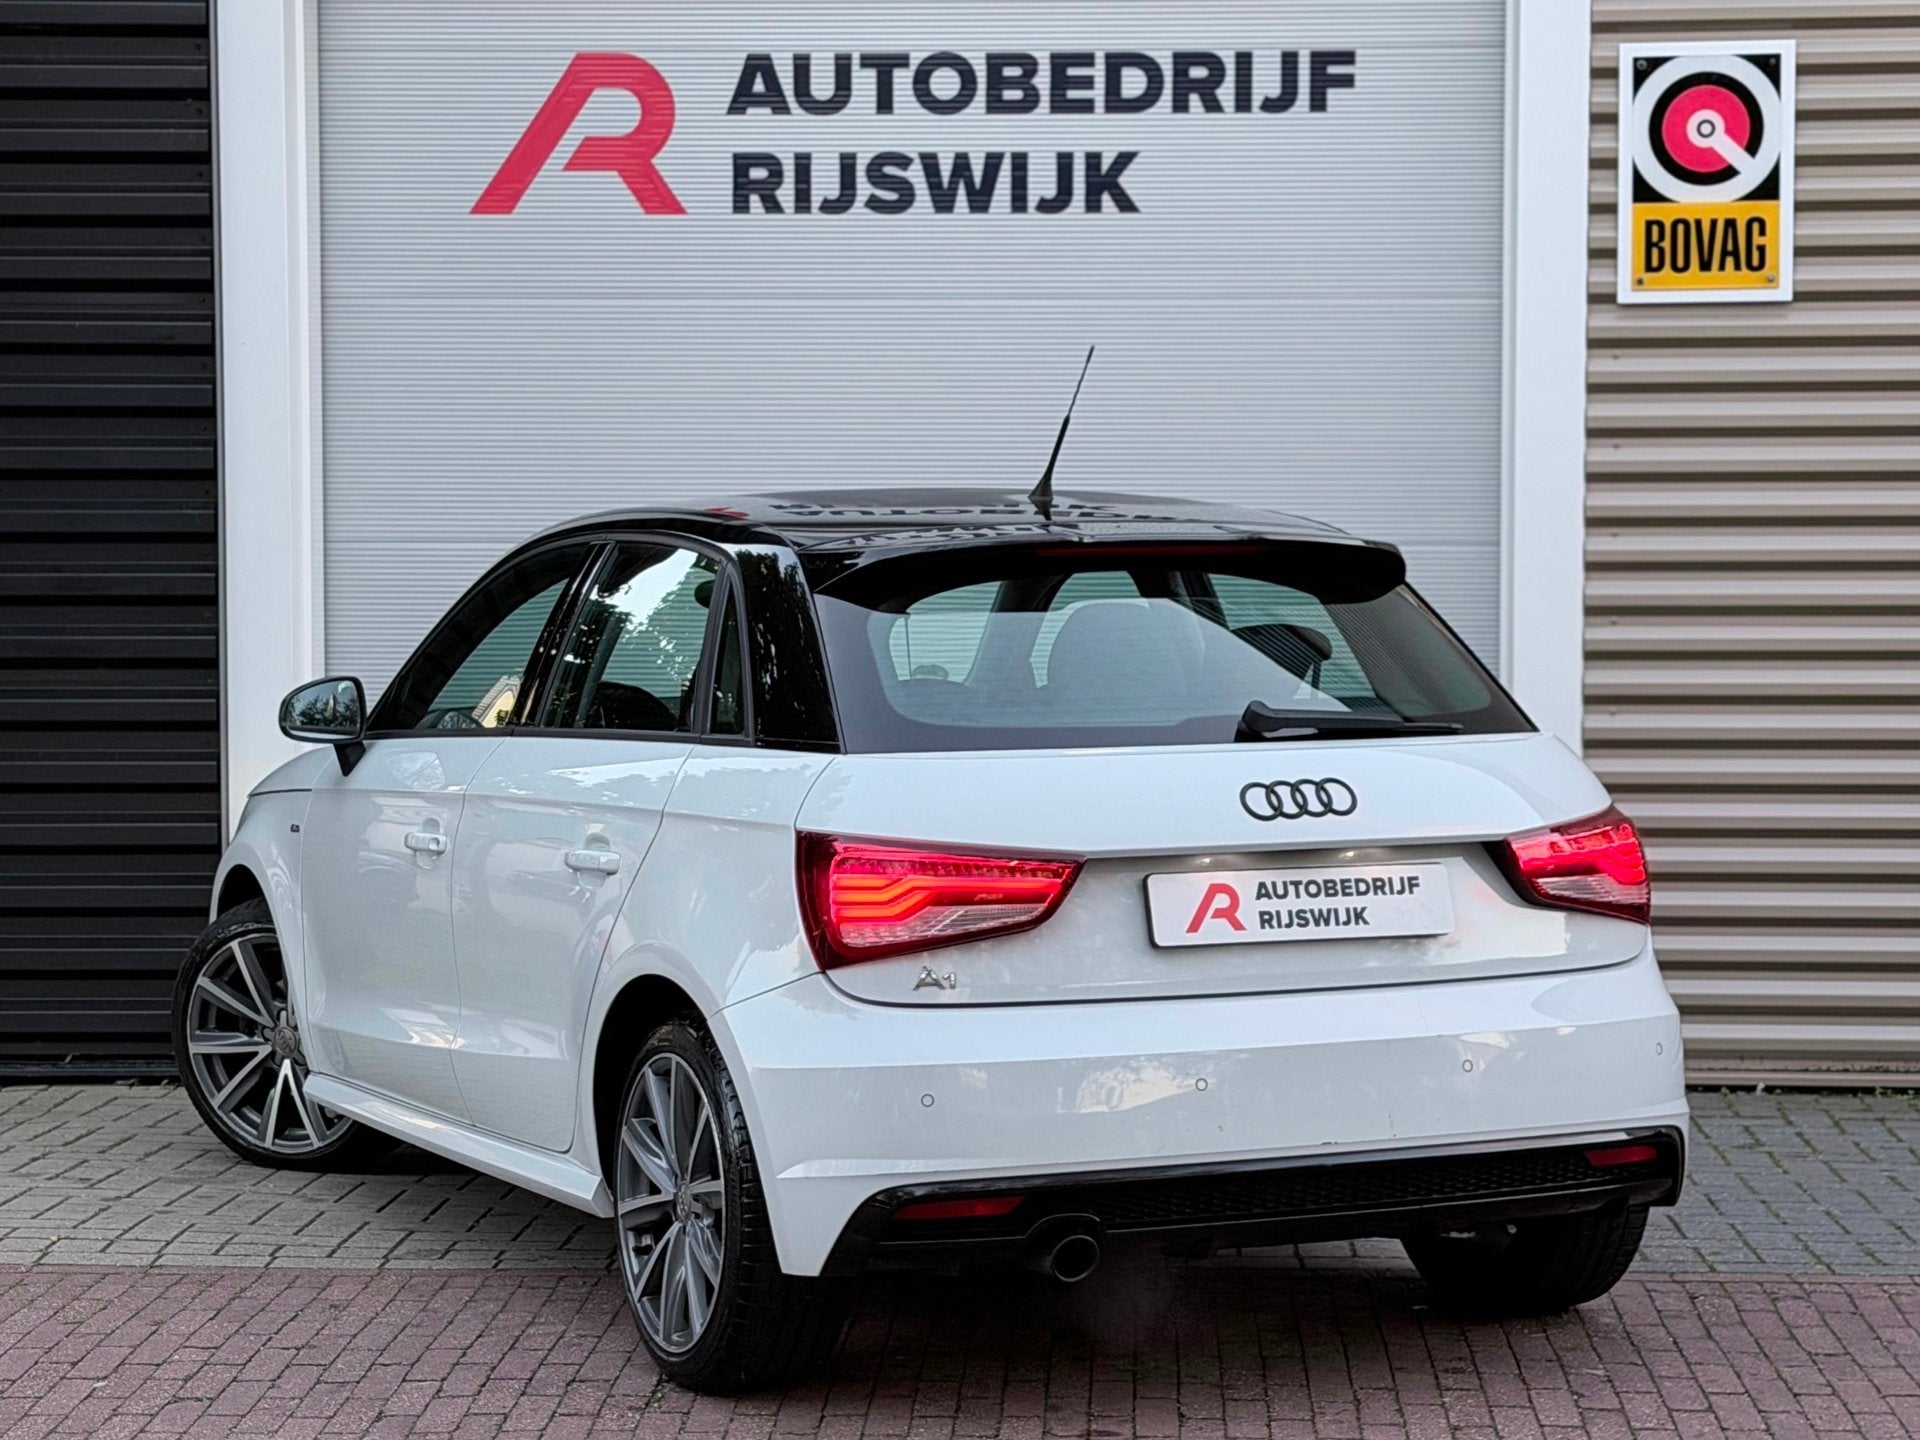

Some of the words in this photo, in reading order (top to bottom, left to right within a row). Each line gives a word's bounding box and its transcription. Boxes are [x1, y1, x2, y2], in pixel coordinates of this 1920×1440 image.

[727, 50, 1356, 115] AUTOBEDRIJF
[732, 150, 1140, 215] RIJSWIJK
[1645, 216, 1767, 273] BOVAG
[1255, 875, 1420, 900] AUTOBEDRIJF
[1258, 906, 1370, 930] RIJSWIJK
[912, 965, 956, 991] A1
